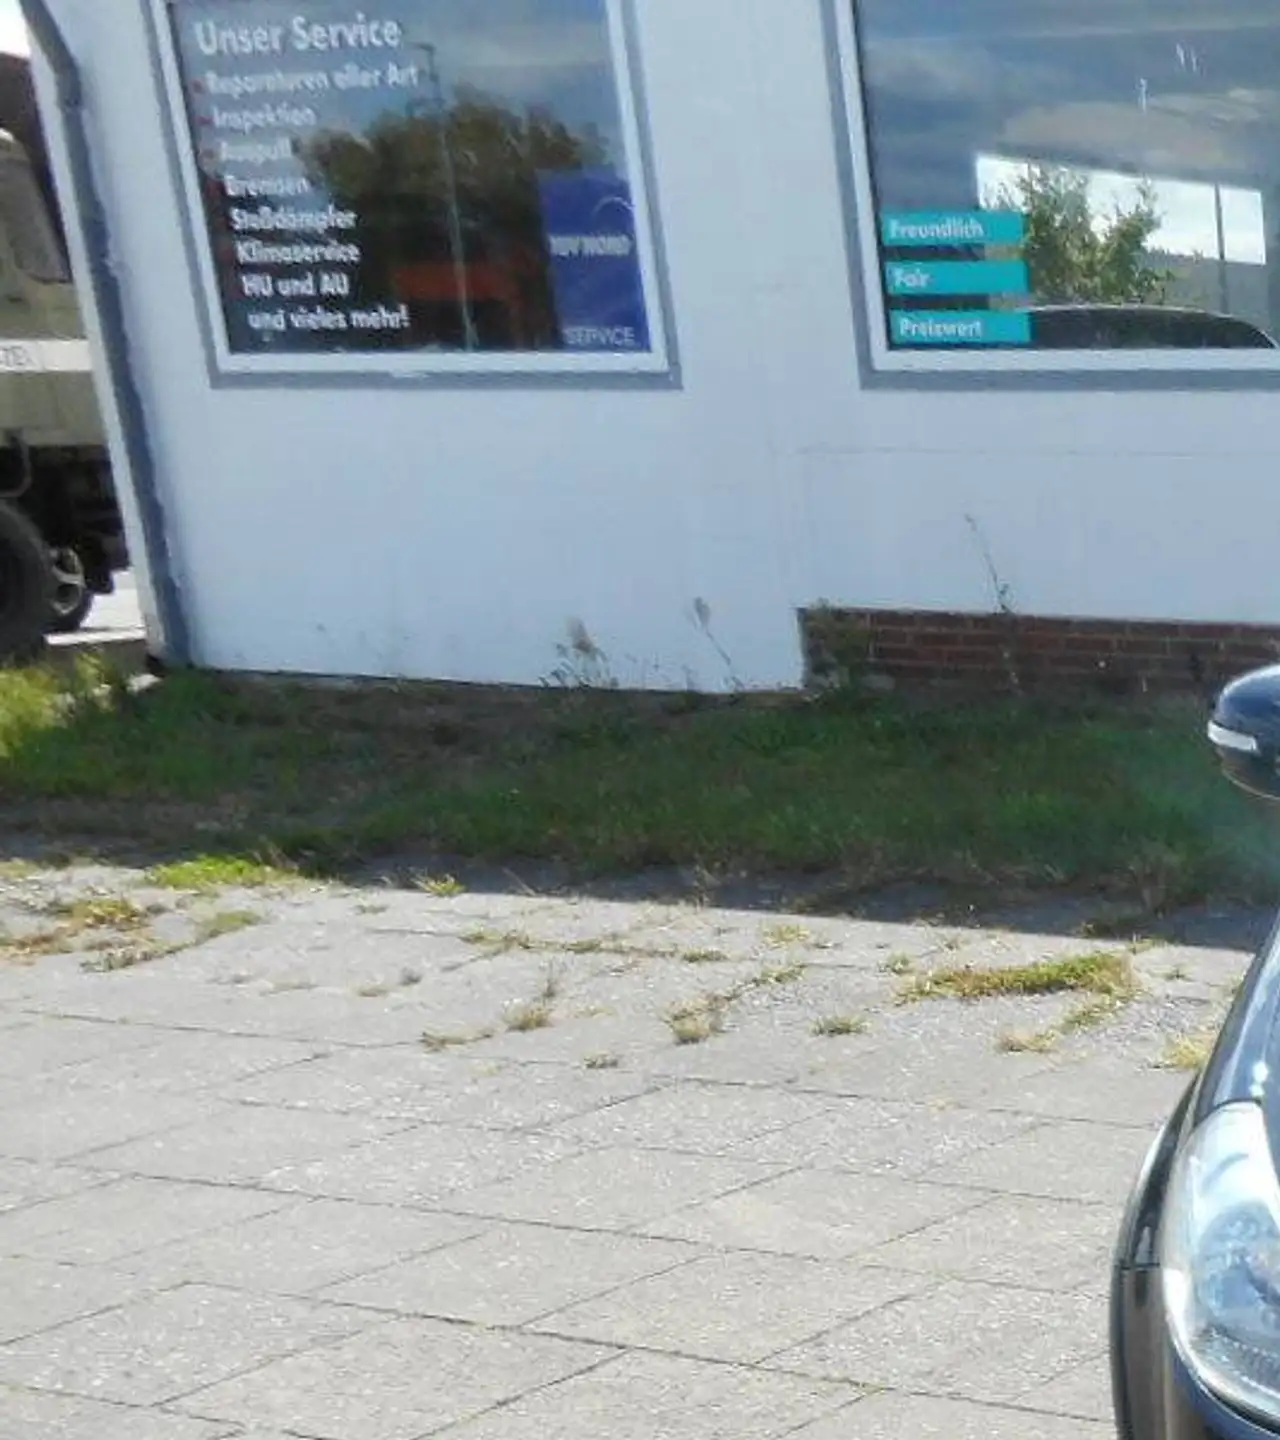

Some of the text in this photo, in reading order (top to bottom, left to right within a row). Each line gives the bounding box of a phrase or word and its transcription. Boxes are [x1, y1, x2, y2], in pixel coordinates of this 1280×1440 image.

[194, 12, 401, 55] Unser Service
[386, 61, 418, 89] Art
[212, 101, 317, 132] Inspektion
[889, 215, 985, 239] Freundlich
[235, 238, 361, 265] Klimaservice
[241, 272, 350, 297] HU und AU
[893, 266, 931, 288] Fair
[247, 303, 411, 331] und vieles mehr!
[899, 317, 981, 338] Preiswert
[563, 326, 636, 346] SERVICE
